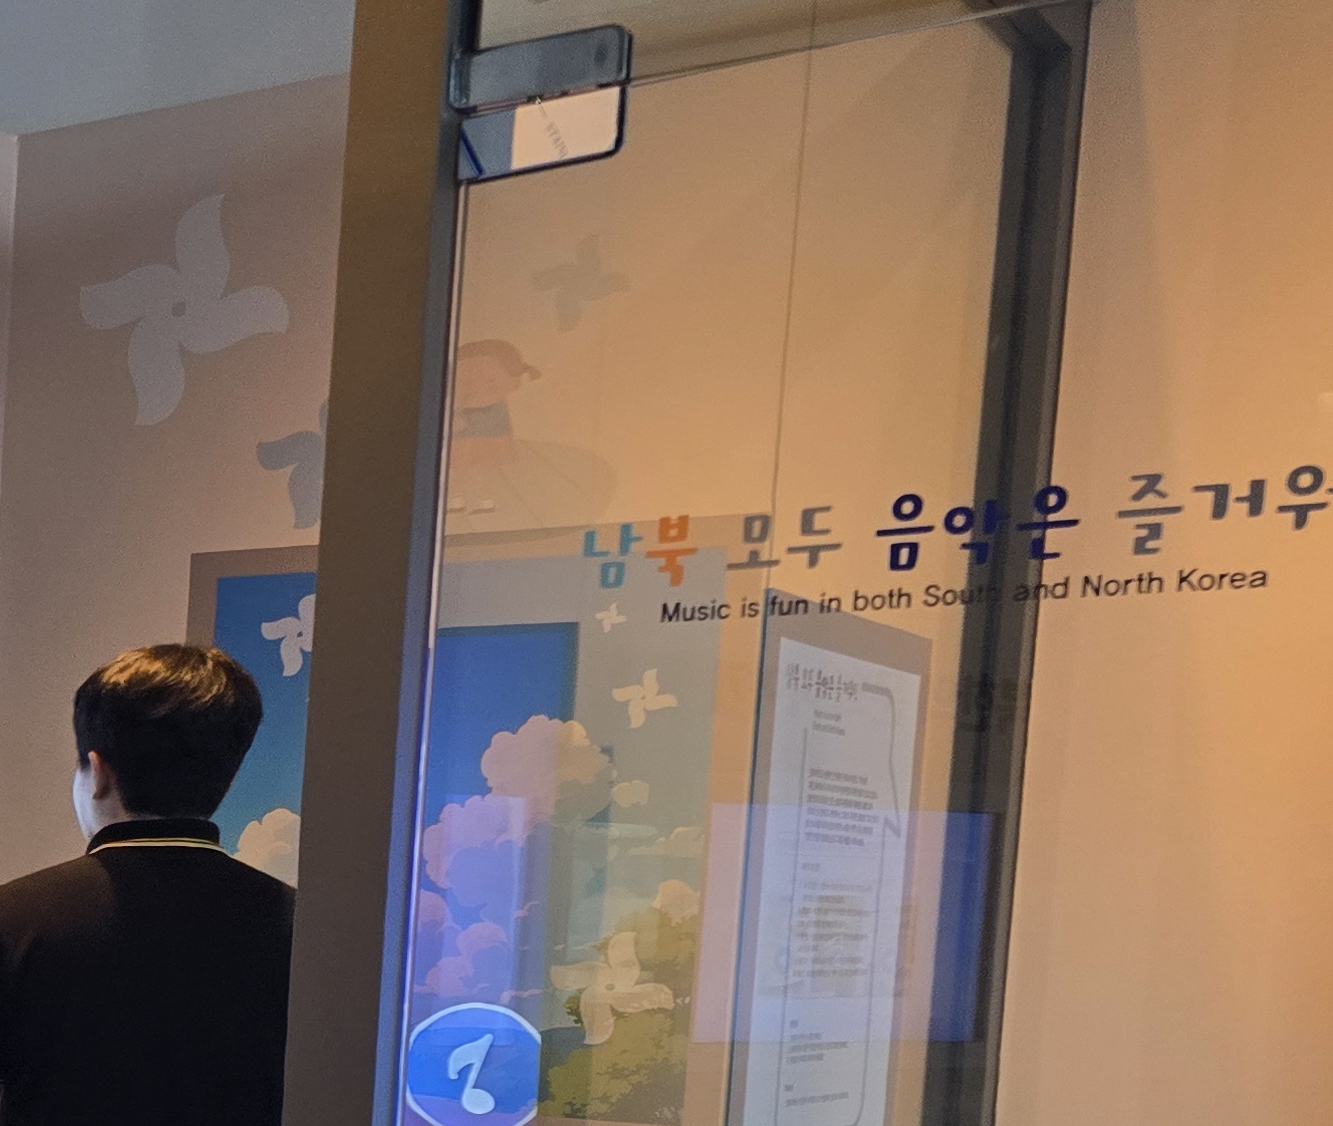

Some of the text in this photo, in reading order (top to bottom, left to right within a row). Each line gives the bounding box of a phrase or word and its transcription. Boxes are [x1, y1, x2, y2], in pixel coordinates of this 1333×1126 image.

[583, 514, 697, 589] 남북
[725, 506, 843, 570] 모두
[876, 484, 1081, 571] 음악은
[660, 598, 732, 625] Music
[739, 597, 760, 619] is
[768, 592, 810, 618] fun
[819, 592, 842, 614] in
[852, 586, 912, 611] both
[1013, 576, 1070, 602] and
[1079, 570, 1165, 598] North
[1176, 568, 1269, 592] Korea
